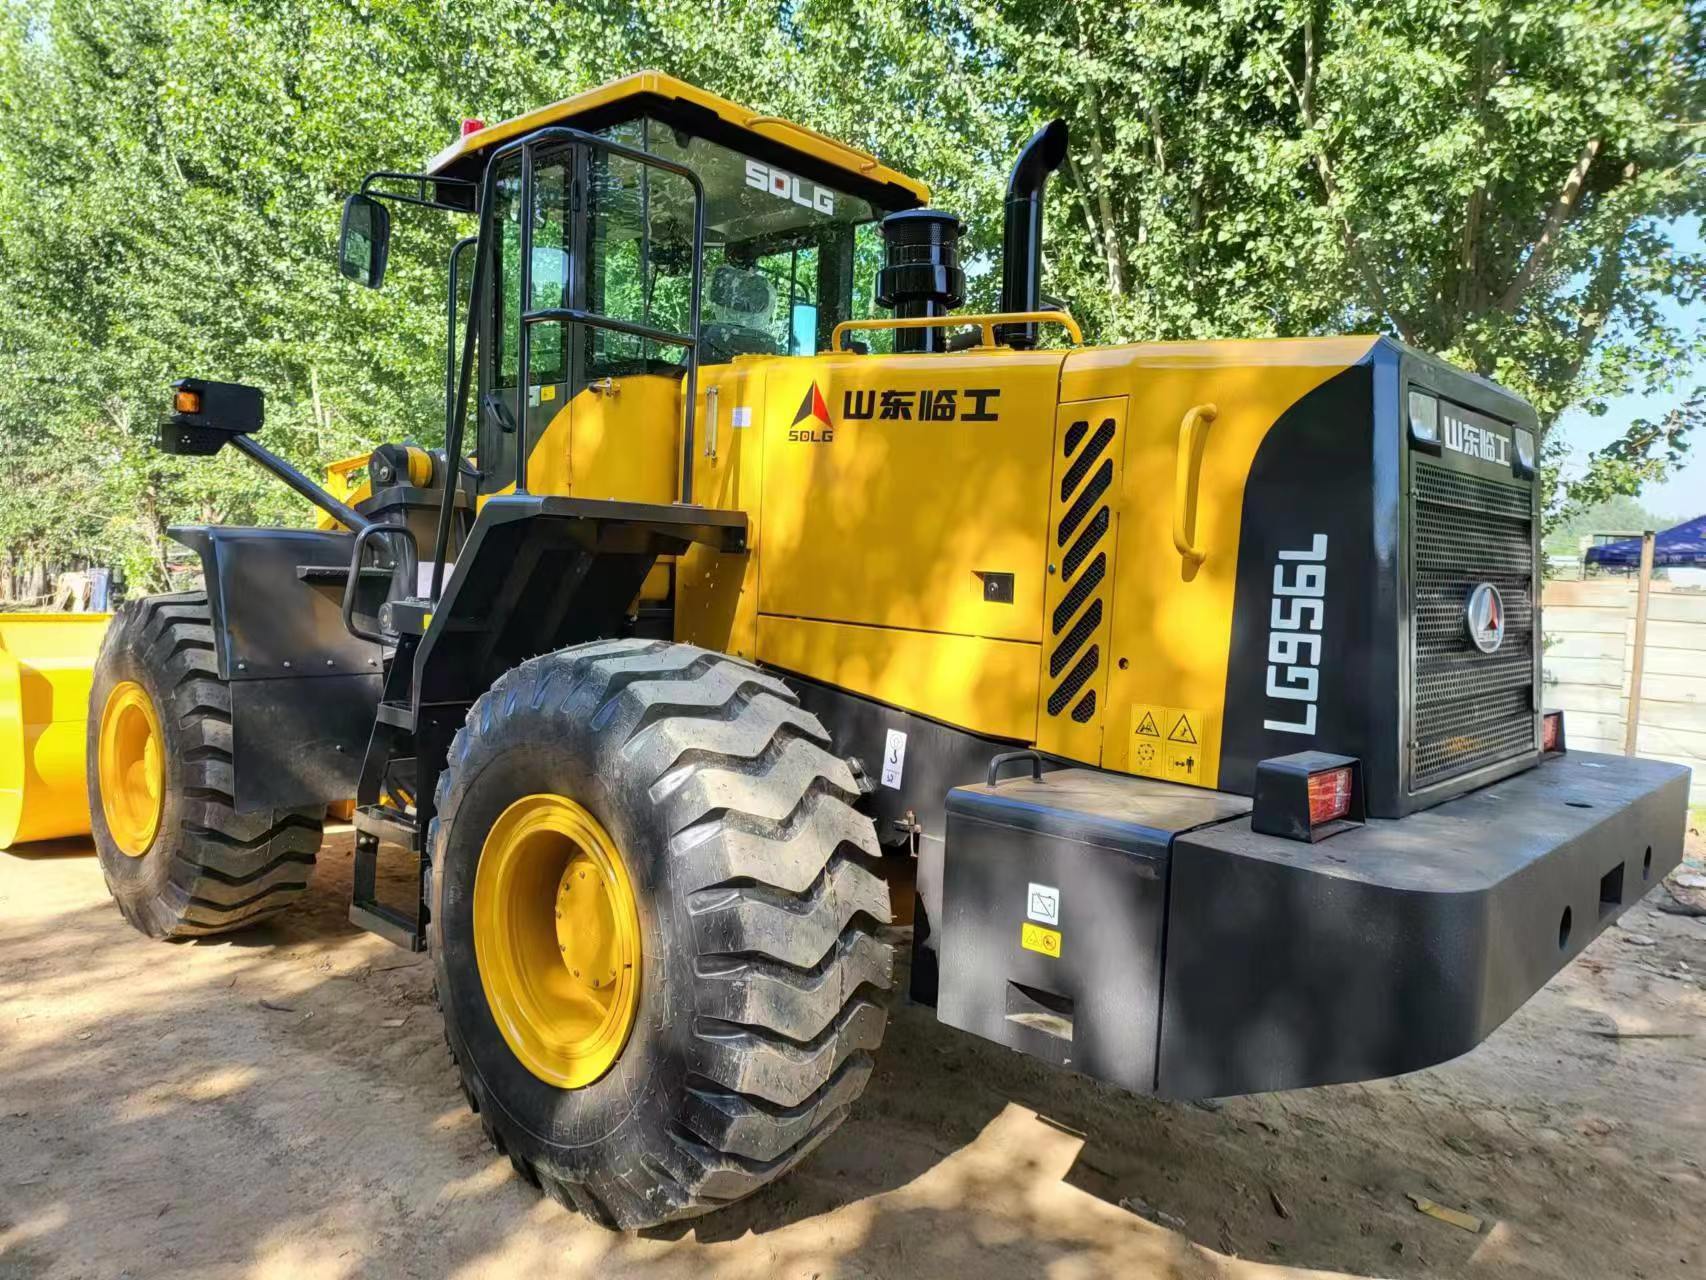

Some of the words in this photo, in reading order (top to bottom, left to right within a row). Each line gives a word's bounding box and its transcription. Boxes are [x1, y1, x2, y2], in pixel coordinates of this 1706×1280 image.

[746, 160, 834, 216] SDLG
[843, 389, 1000, 421] 山东临工
[788, 430, 833, 442] SDLG
[1444, 416, 1510, 467] 山东临工
[1264, 533, 1328, 736] LG956L
